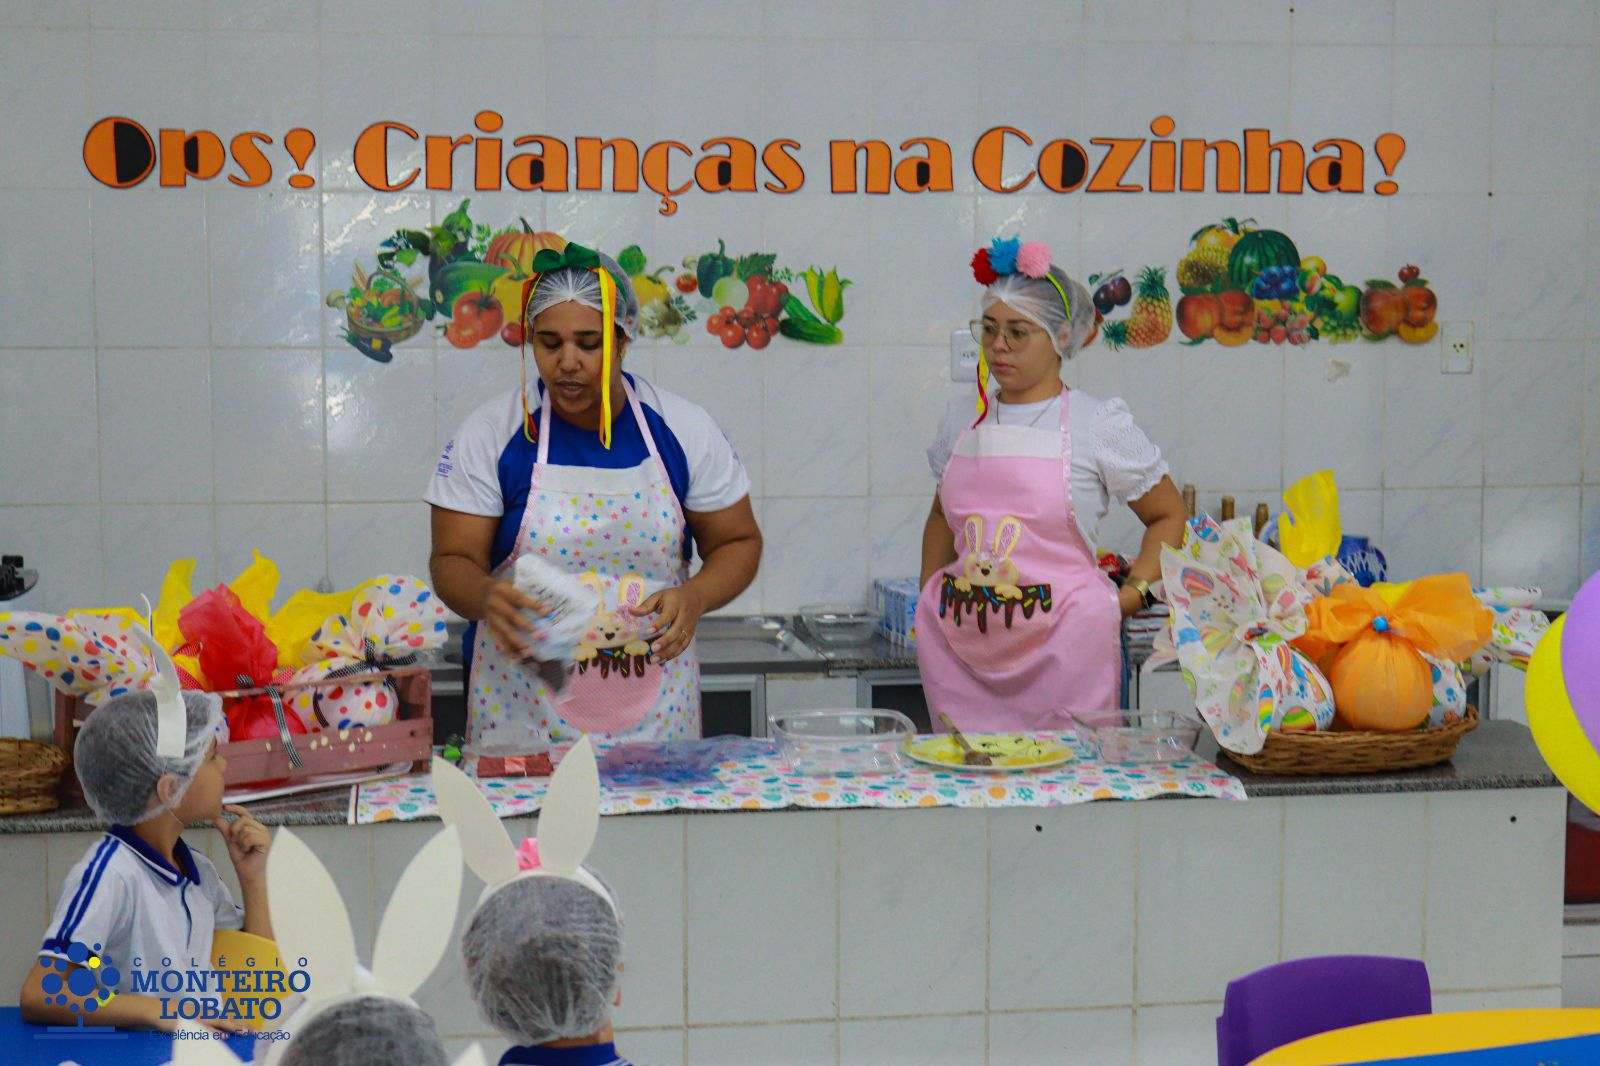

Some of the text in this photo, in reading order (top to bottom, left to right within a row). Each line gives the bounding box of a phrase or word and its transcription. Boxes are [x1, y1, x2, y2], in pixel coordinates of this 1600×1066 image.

[83, 110, 1406, 216] Ops! Crianças na Cozinha!
